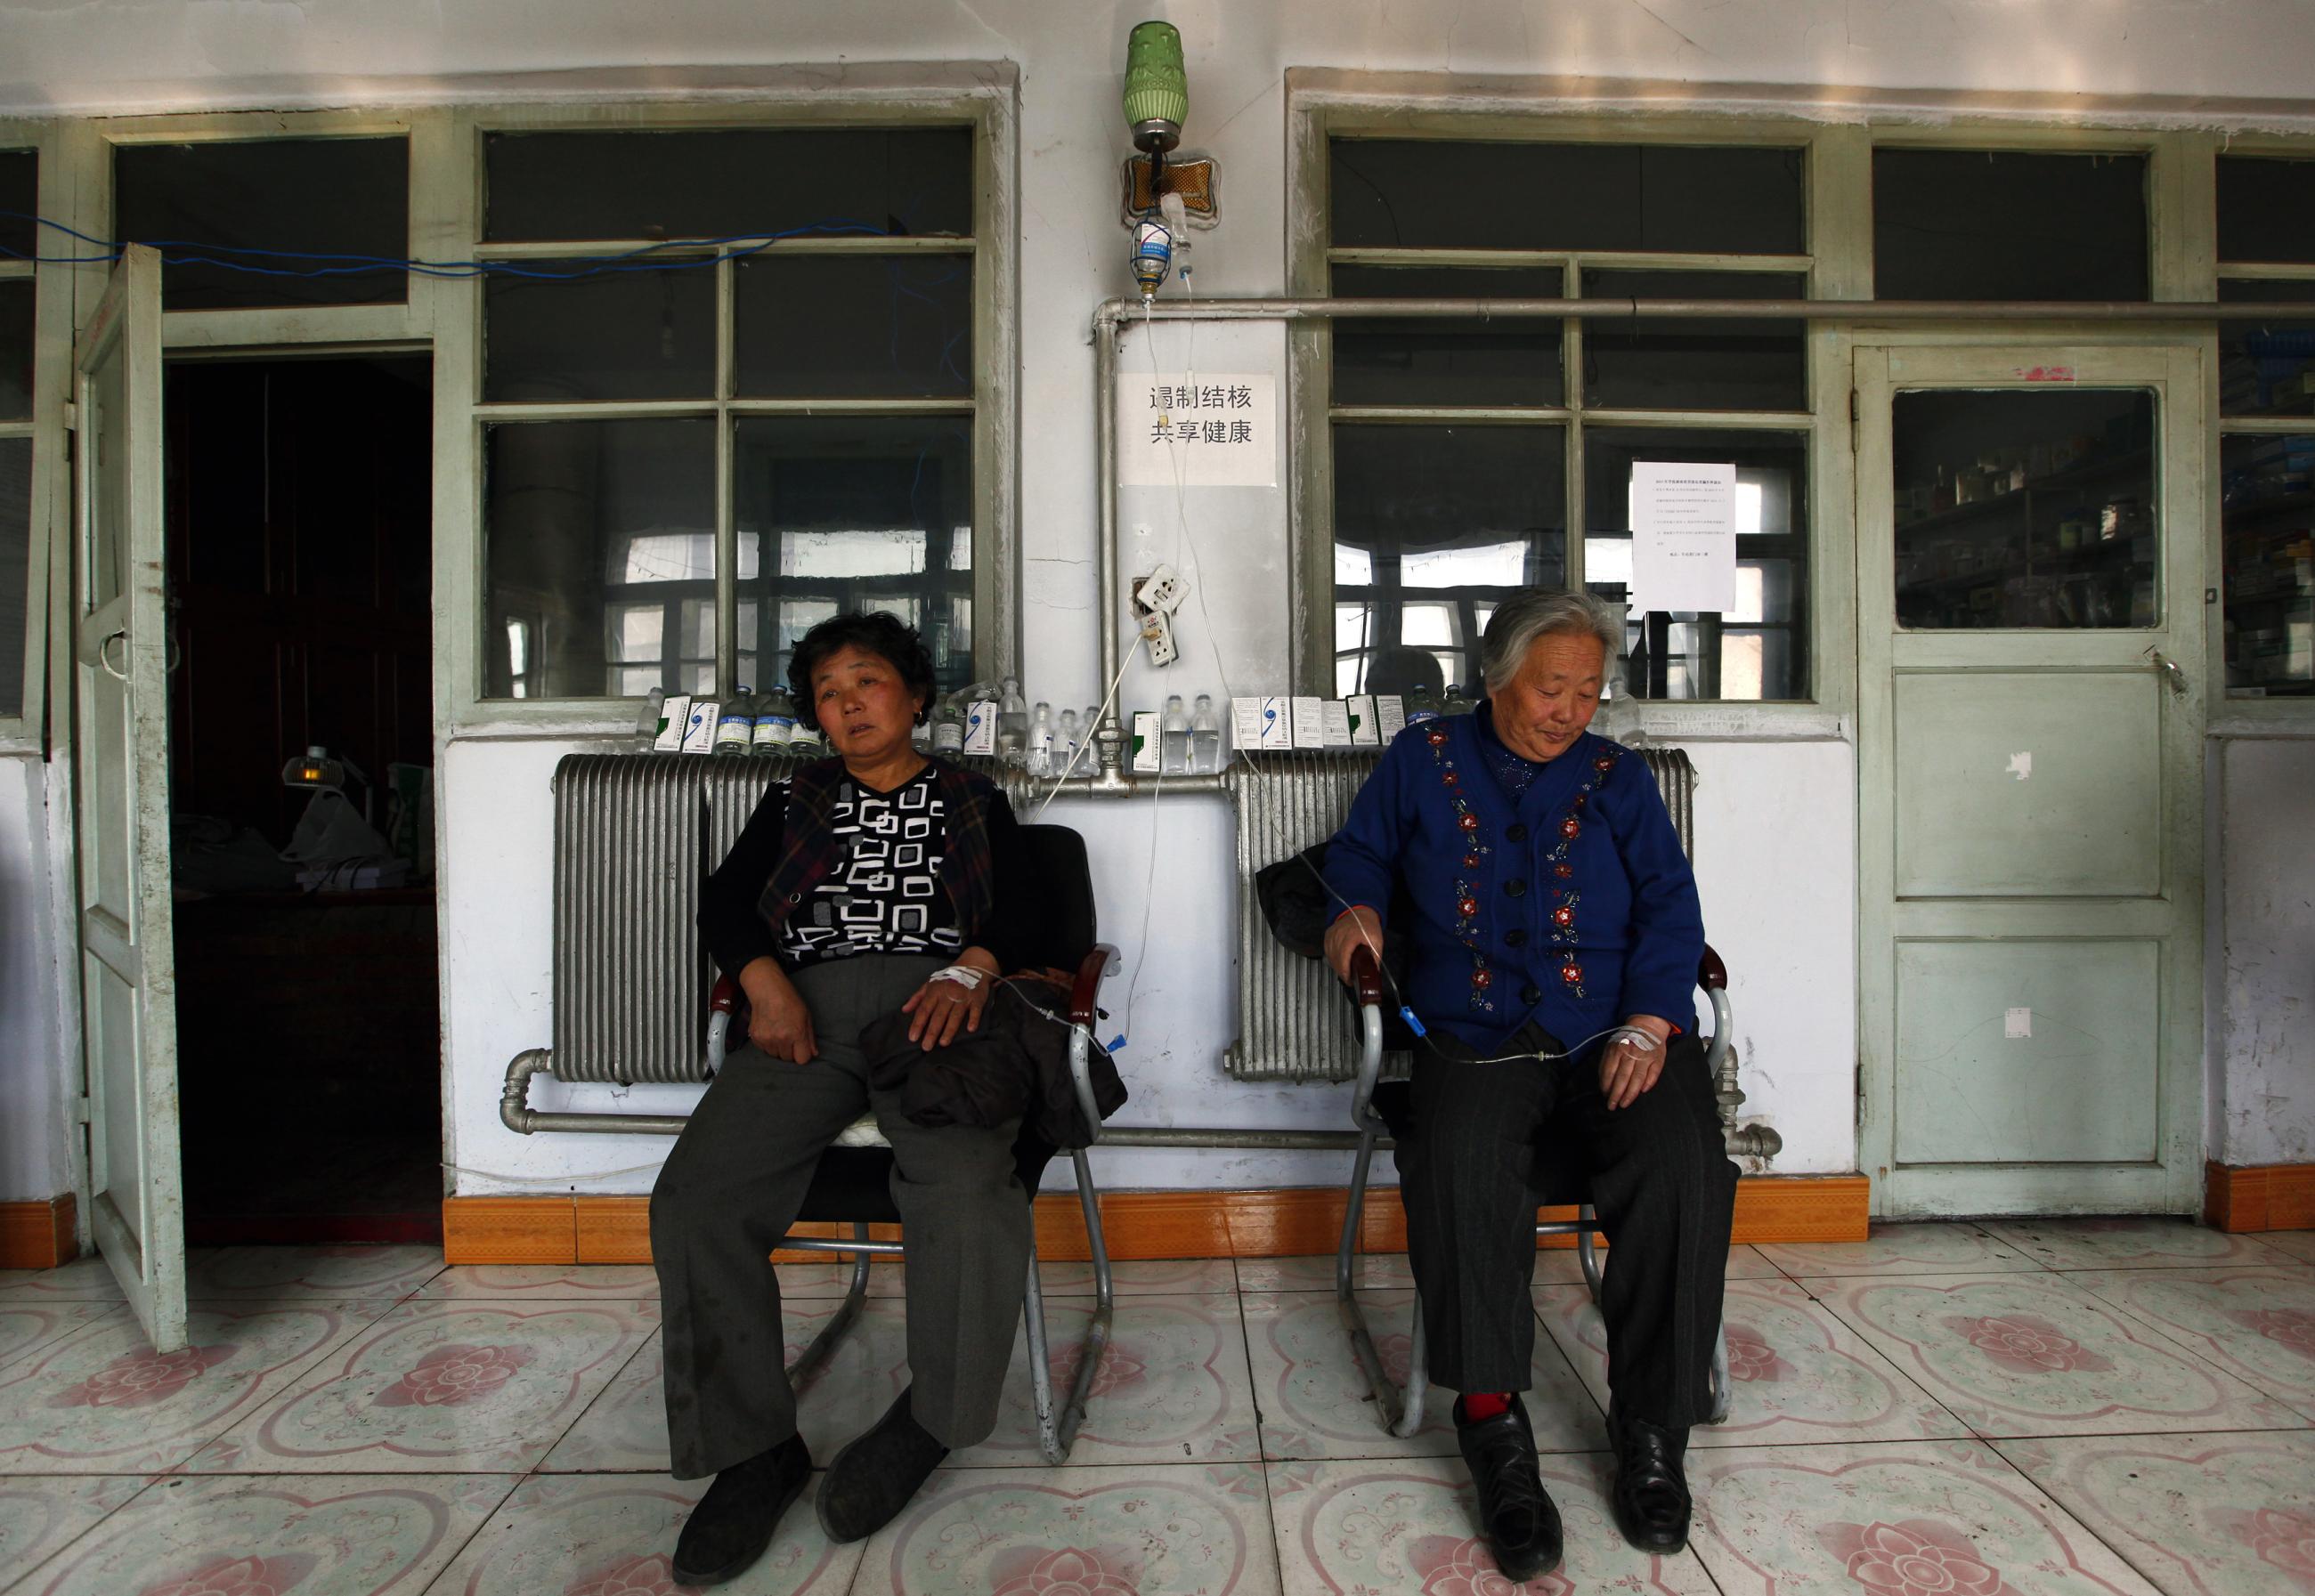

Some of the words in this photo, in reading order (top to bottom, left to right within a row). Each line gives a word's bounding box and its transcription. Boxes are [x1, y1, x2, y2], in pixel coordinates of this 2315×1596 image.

[1149, 385, 1252, 409] 遏制结核
[1150, 419, 1252, 444] 共享健康
